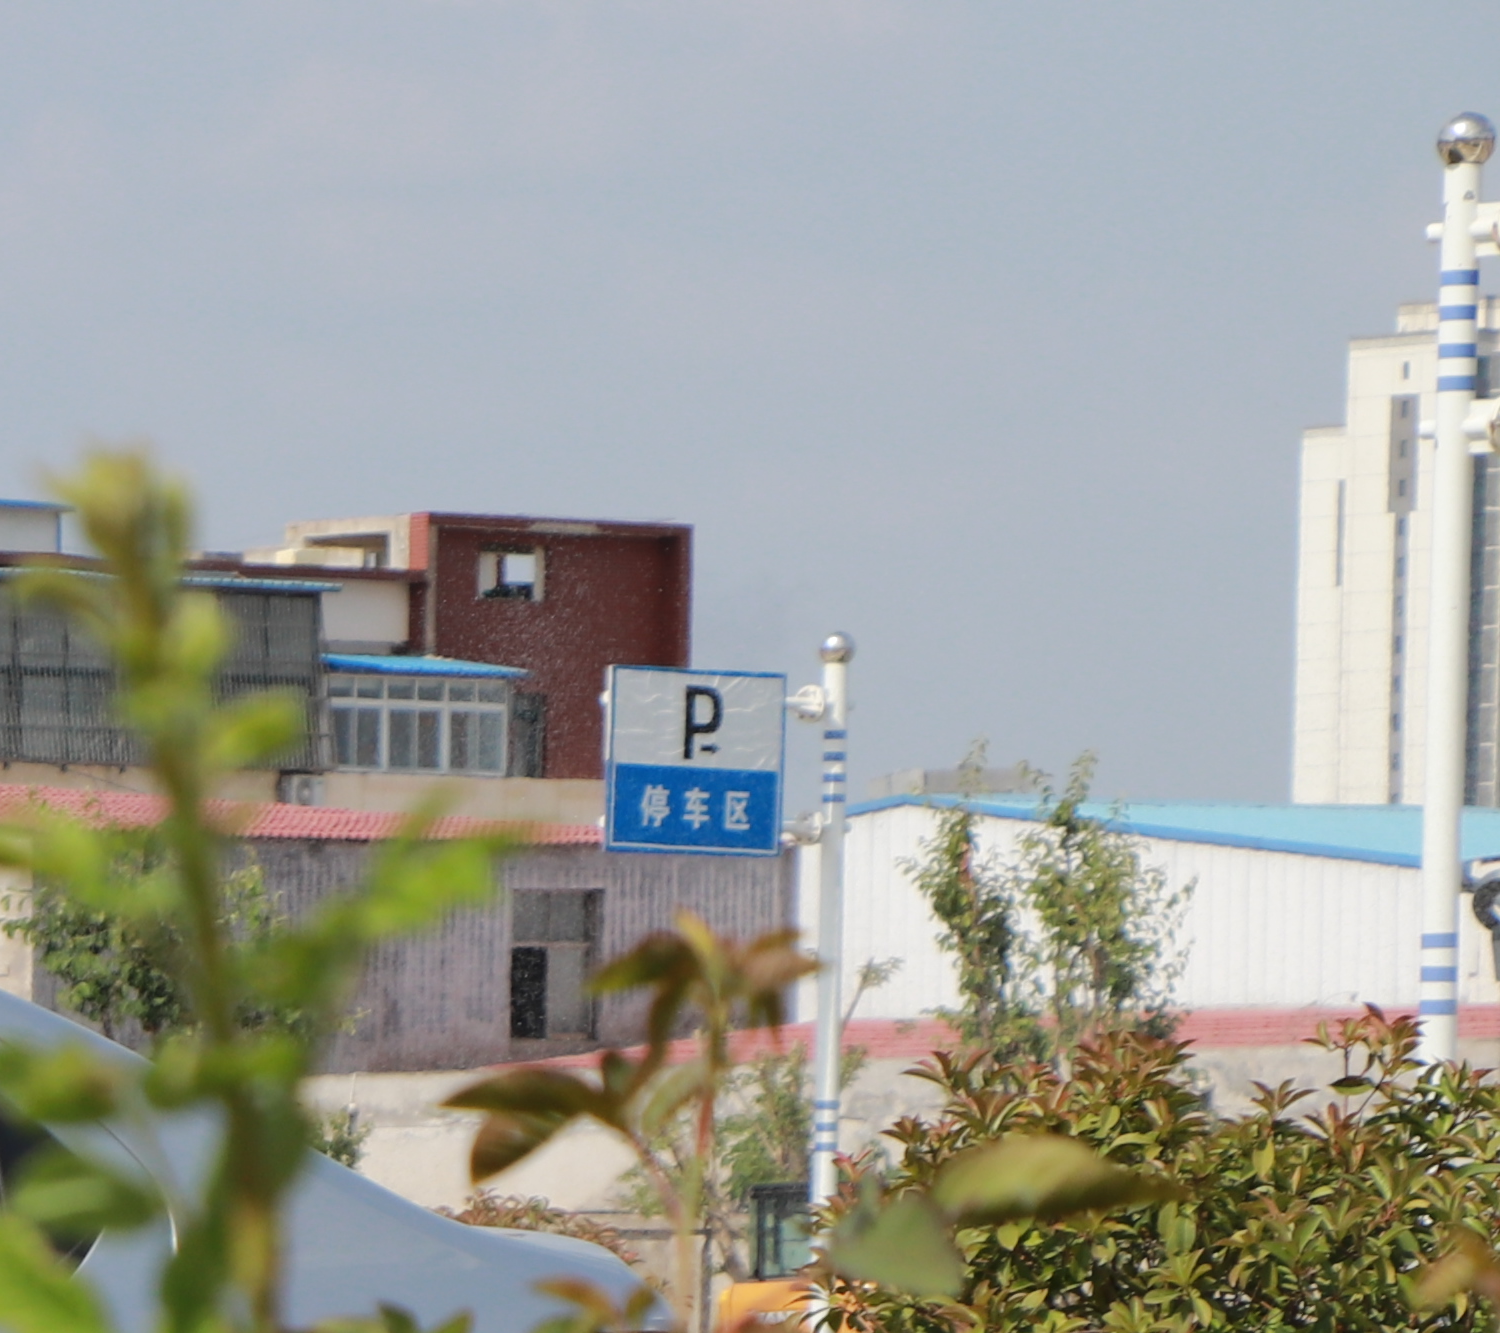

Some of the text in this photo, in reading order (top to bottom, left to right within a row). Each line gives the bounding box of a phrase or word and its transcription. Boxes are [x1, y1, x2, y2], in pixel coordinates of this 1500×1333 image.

[683, 685, 724, 760] P
[640, 784, 750, 831] 停车区
